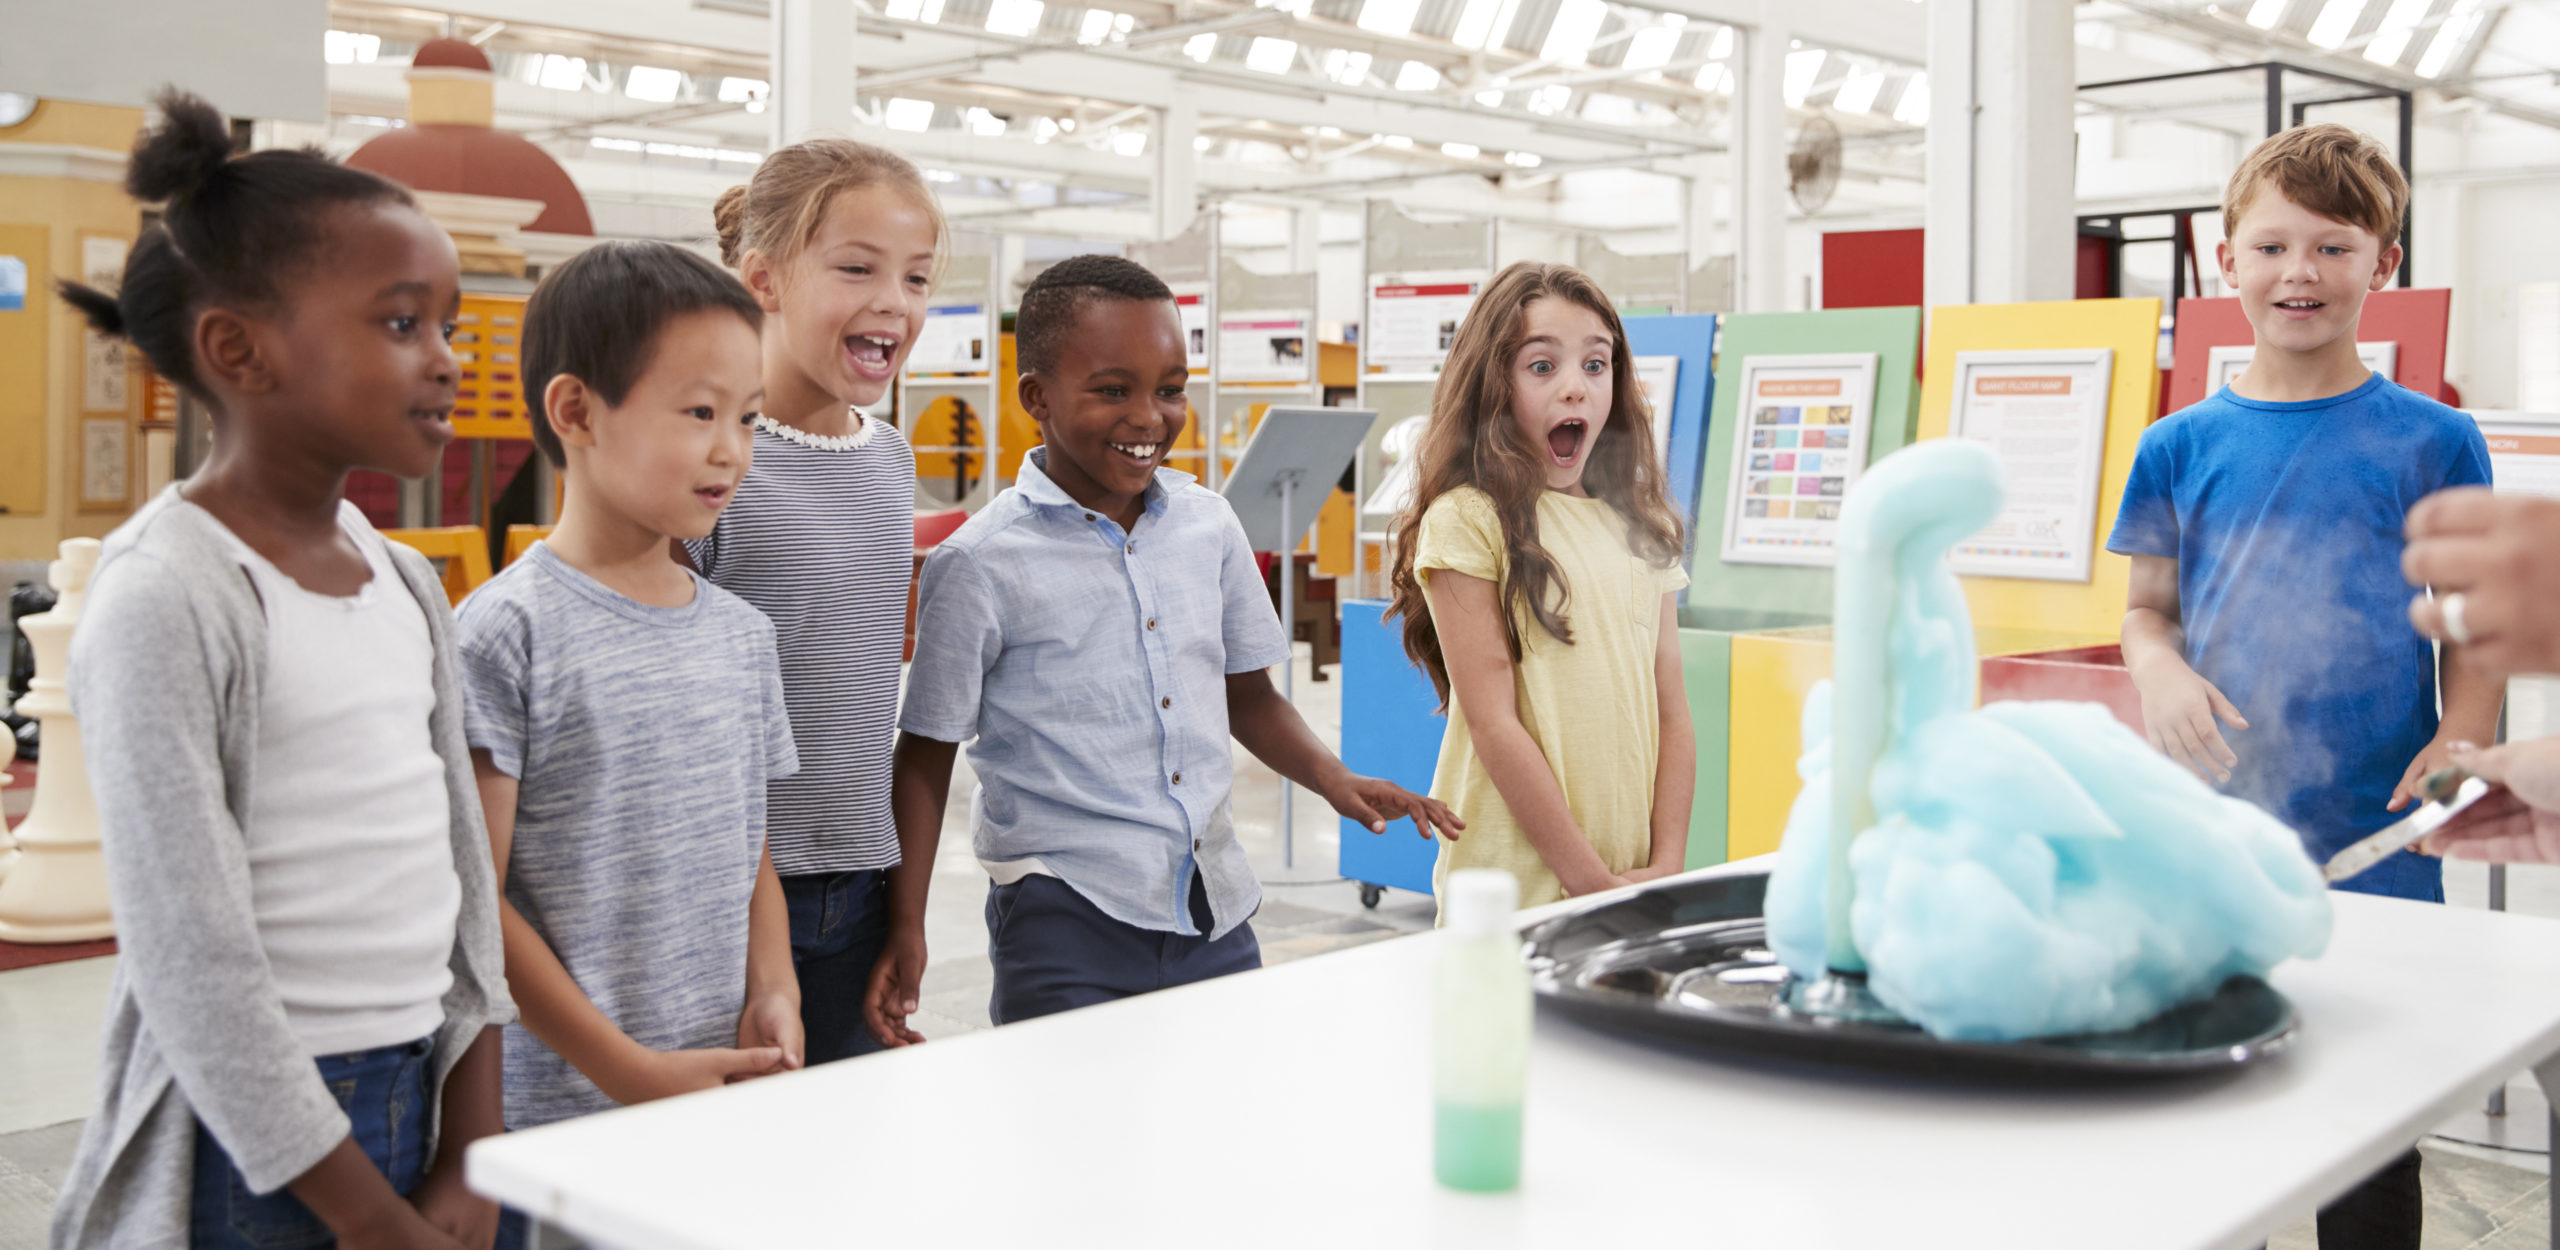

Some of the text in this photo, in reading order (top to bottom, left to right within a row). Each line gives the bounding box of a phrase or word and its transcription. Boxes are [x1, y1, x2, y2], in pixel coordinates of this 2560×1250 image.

[1979, 380, 2064, 392] GIANT FLOOR MAP
[2488, 438, 2519, 449] NON
